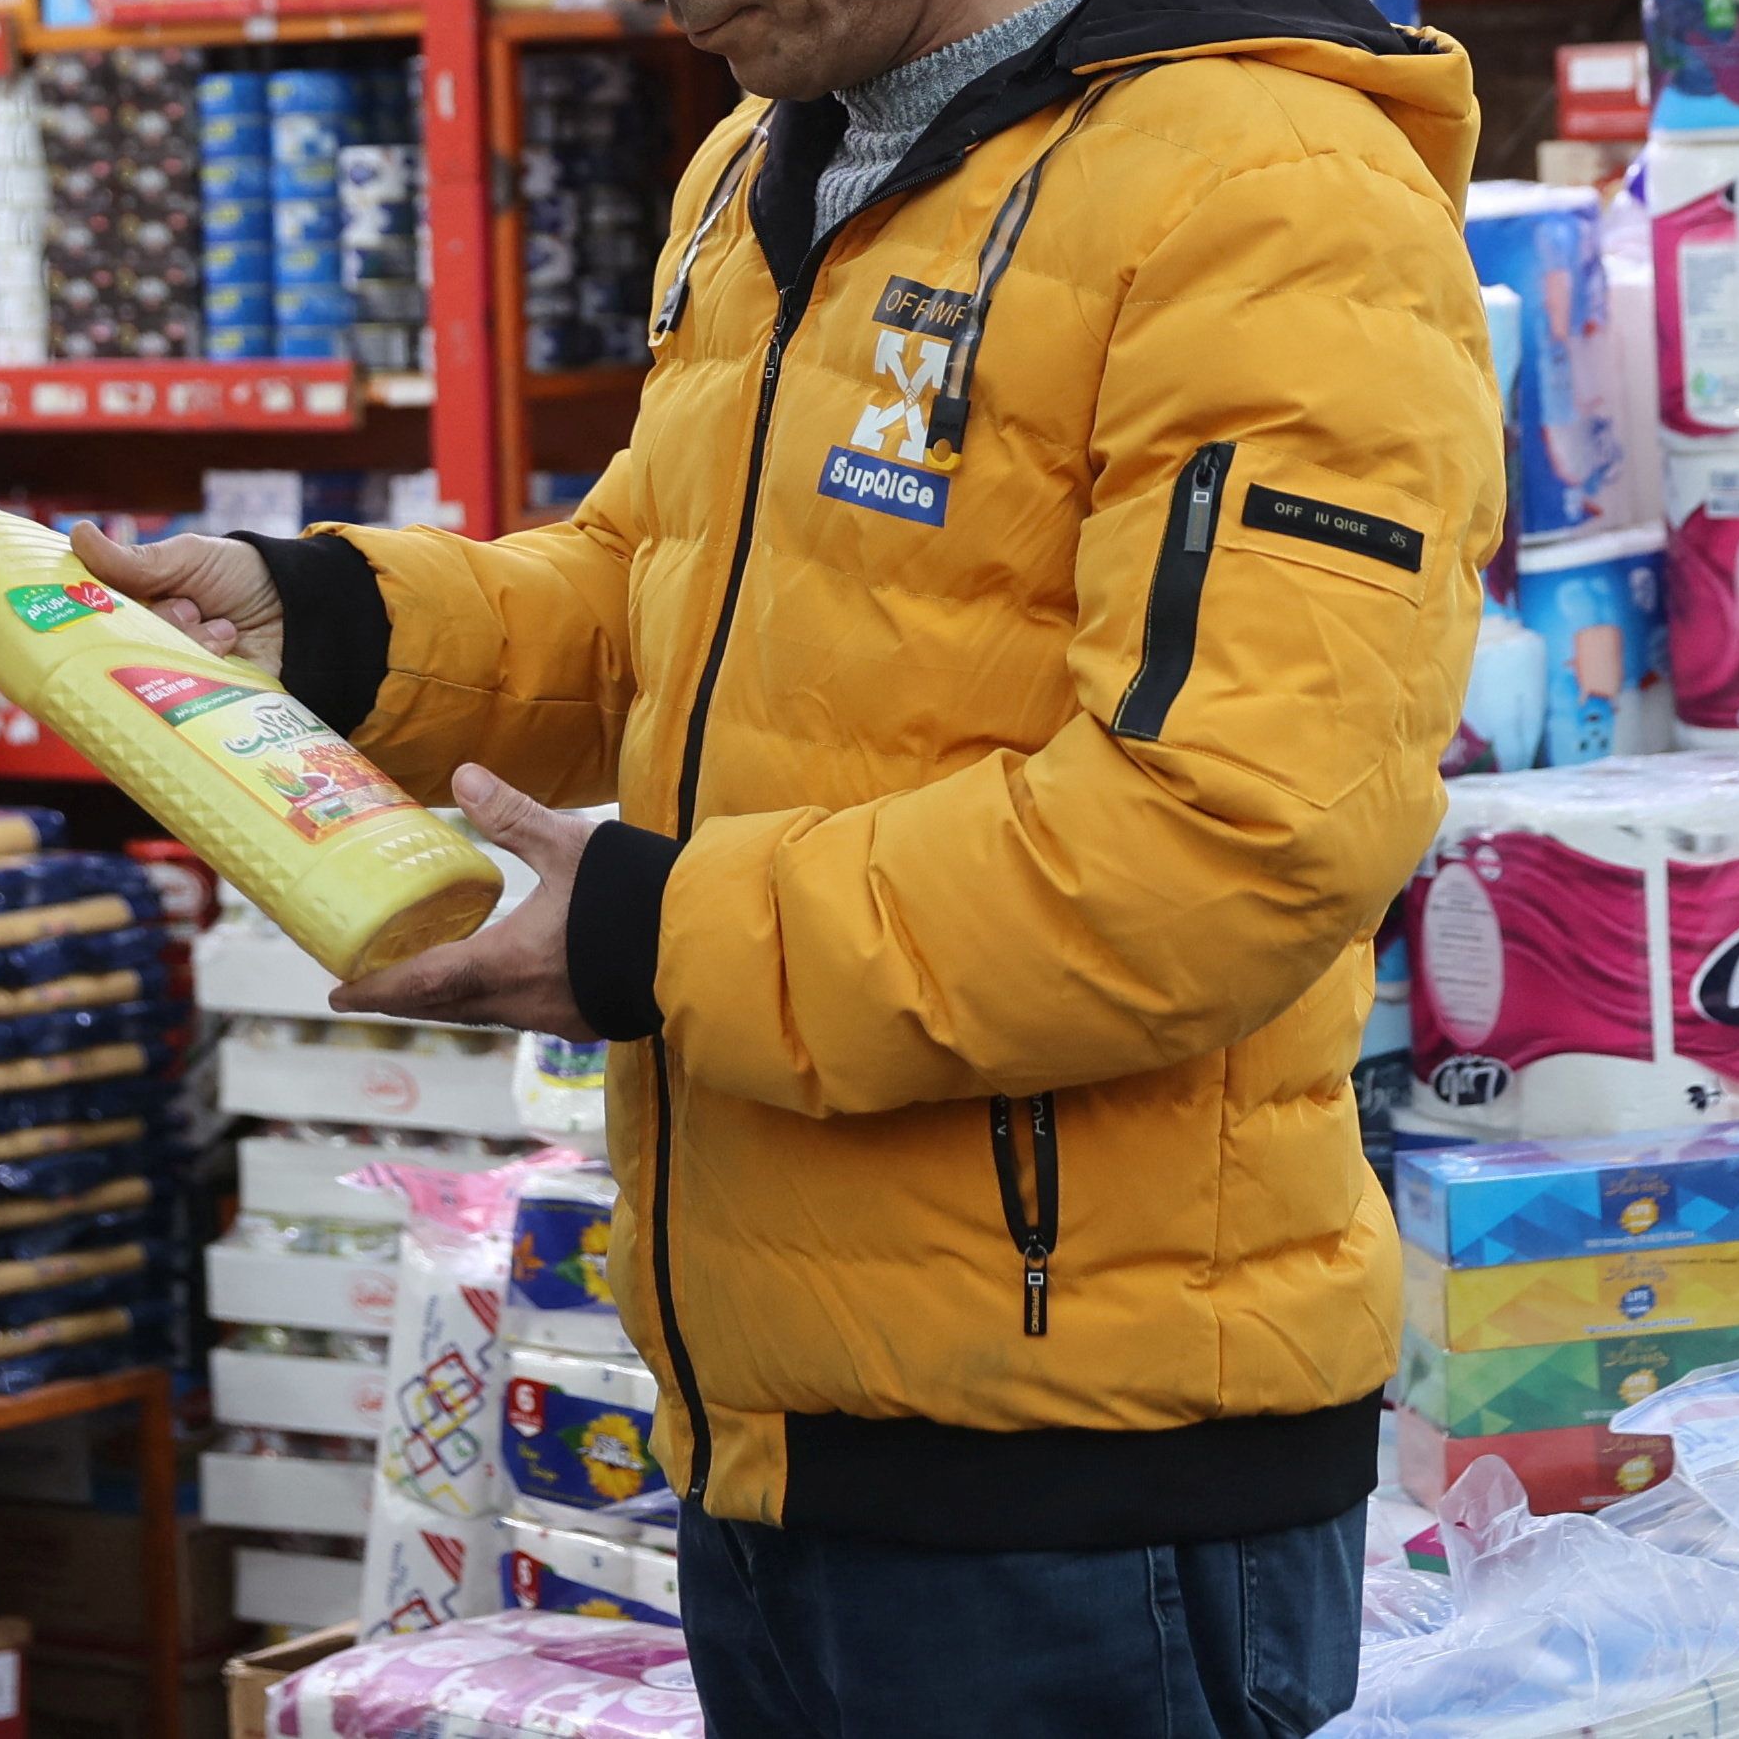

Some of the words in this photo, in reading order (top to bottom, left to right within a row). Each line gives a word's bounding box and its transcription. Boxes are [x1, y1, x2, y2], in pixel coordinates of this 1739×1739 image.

[830, 456, 935, 509] SupQiGe
[1273, 501, 1303, 518] OFF
[1315, 512, 1330, 525] IU
[1334, 517, 1369, 536] QIGE
[1389, 530, 1408, 549] 85
[27, 601, 49, 623] پالم
[144, 684, 177, 704] HEALTHY
[178, 676, 198, 691] DISH
[516, 1382, 534, 1414] 6
